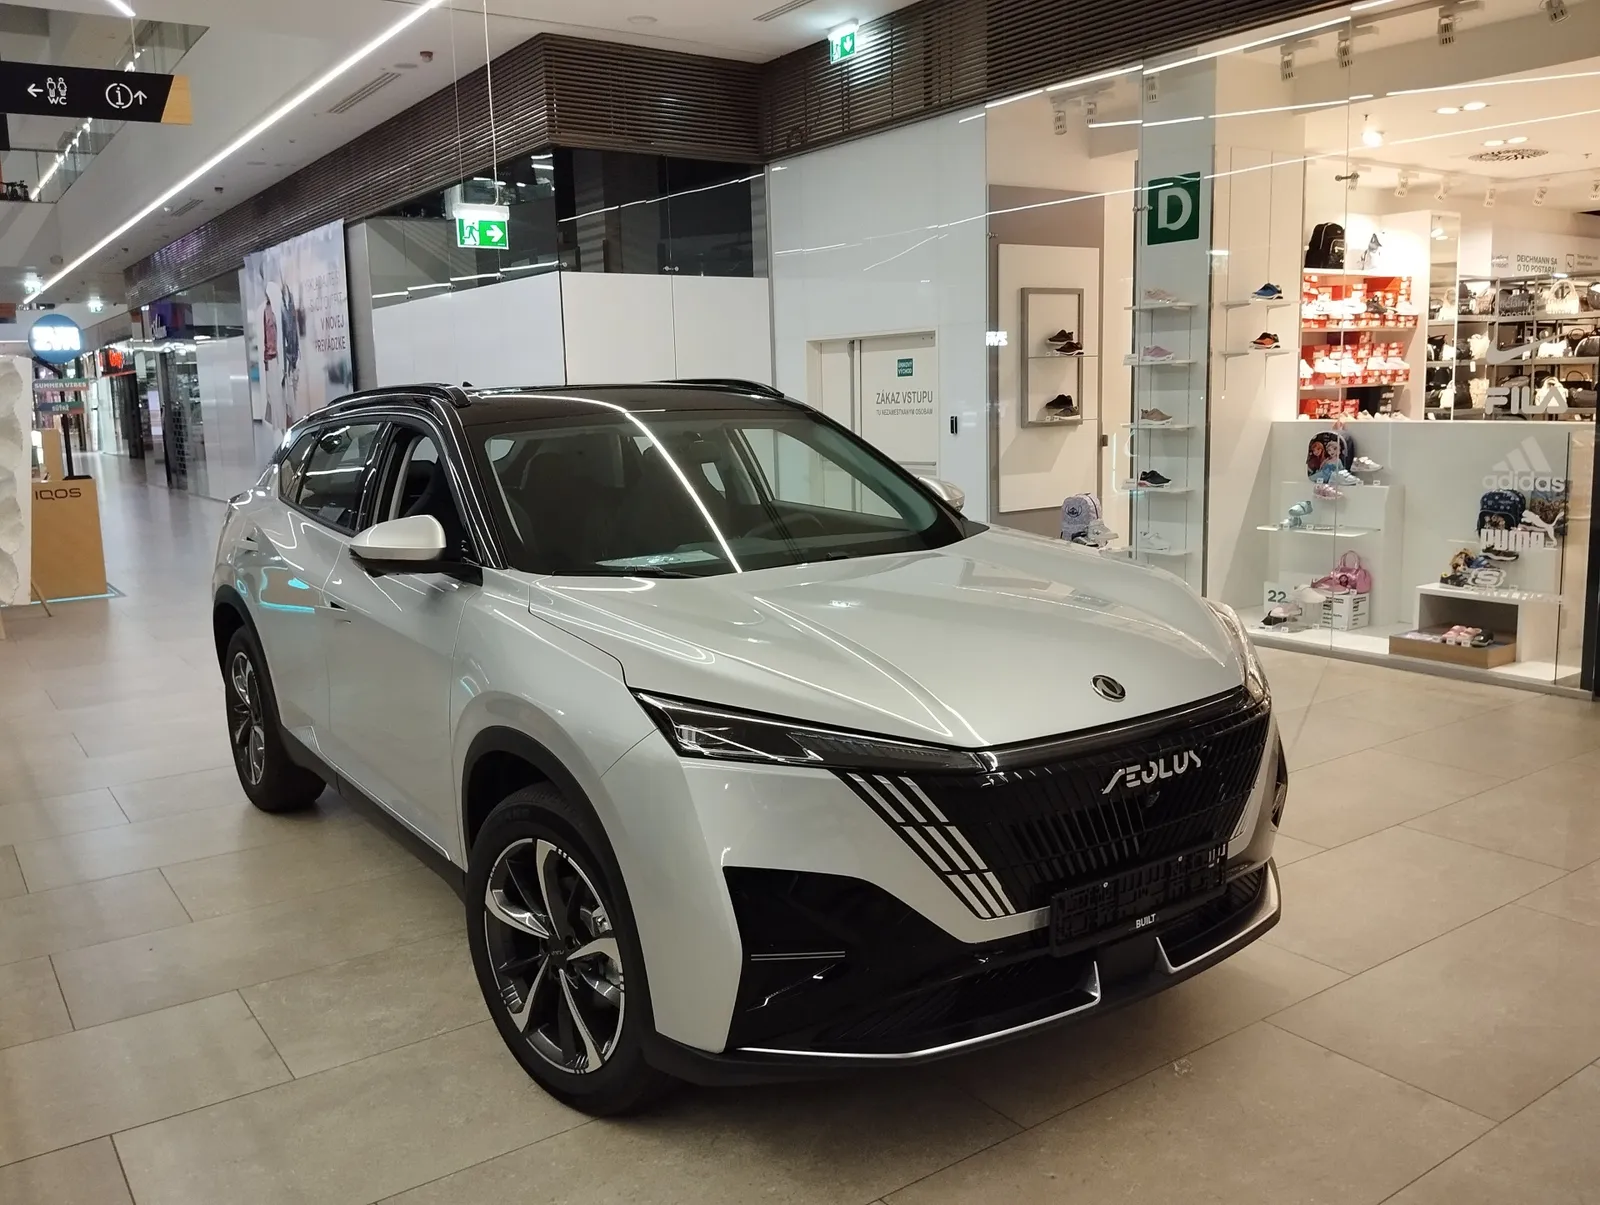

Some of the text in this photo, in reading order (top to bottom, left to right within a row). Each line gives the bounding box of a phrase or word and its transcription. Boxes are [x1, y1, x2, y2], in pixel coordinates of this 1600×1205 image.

[48, 96, 67, 105] WC
[1158, 187, 1192, 231] D
[1517, 254, 1550, 265] DEICHMANN
[876, 389, 933, 404] ZÁKAZ VSTUPU
[1485, 386, 1568, 414] FILA
[1482, 472, 1566, 492] adidas
[35, 488, 81, 500] IQOS
